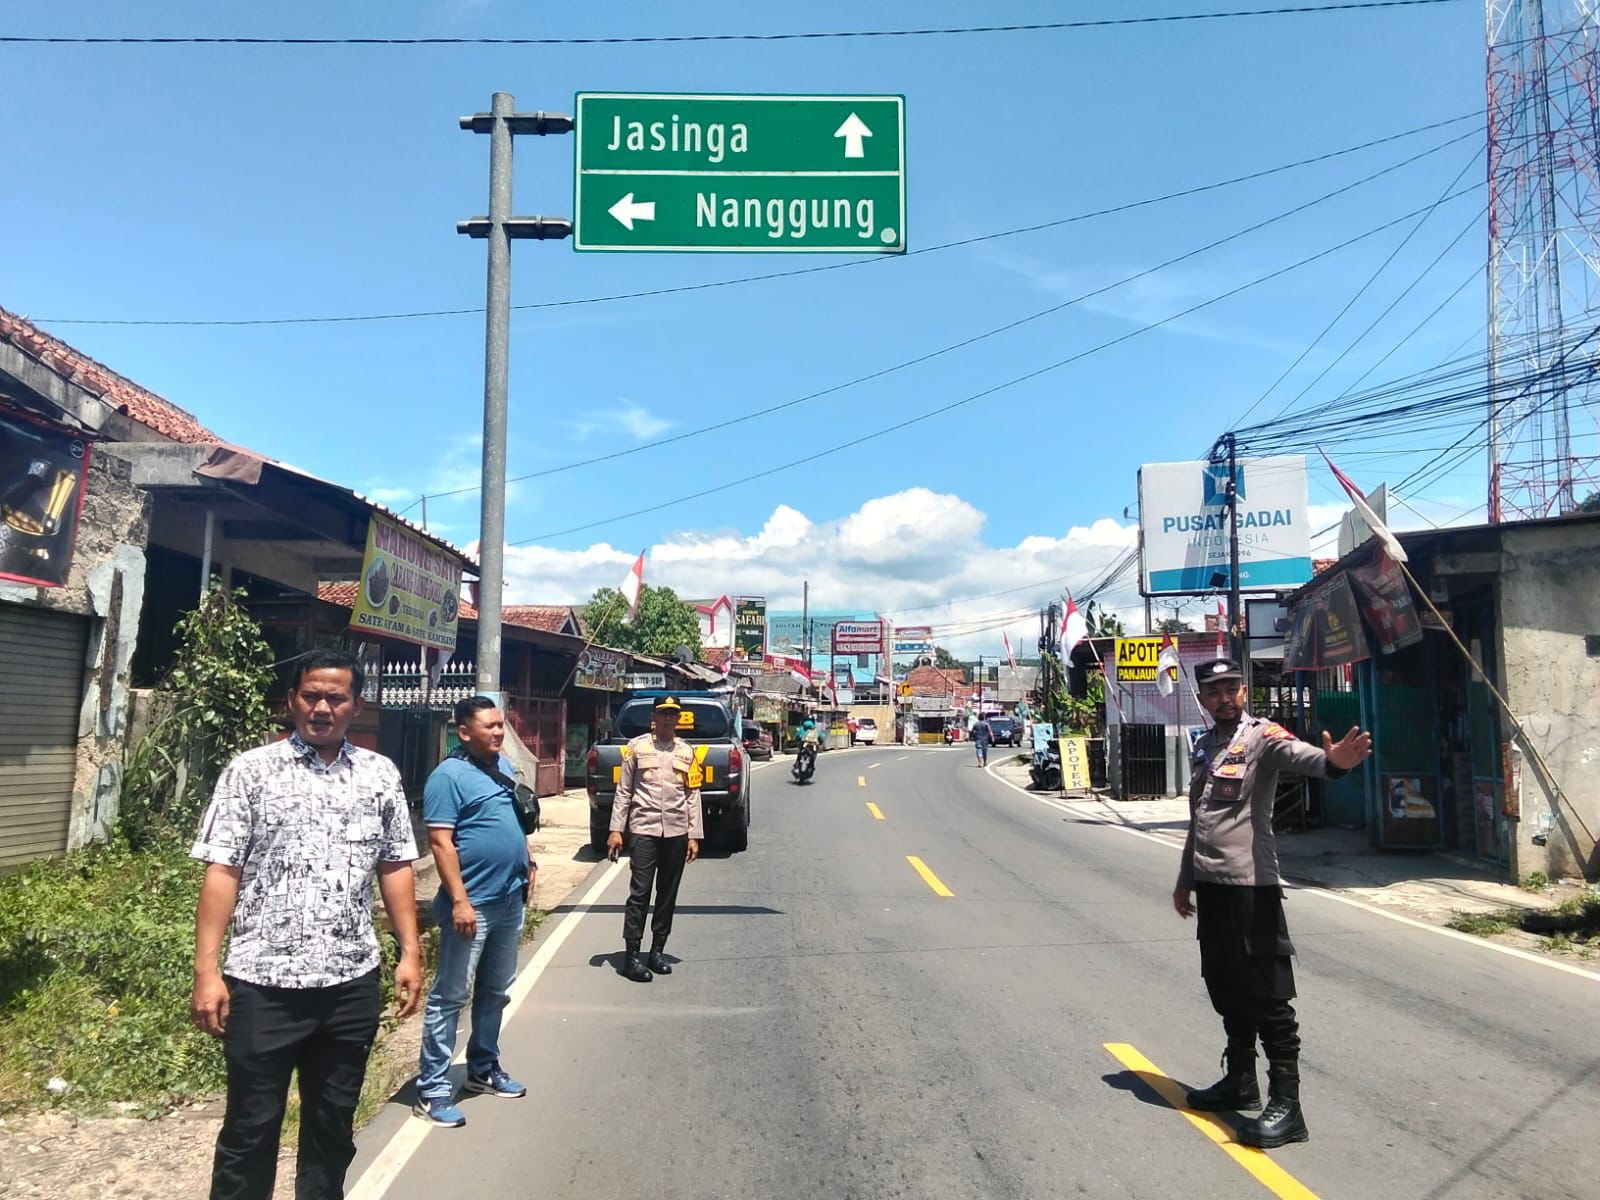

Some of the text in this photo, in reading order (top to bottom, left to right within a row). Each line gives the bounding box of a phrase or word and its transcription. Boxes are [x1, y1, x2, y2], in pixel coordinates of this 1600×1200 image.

[607, 114, 749, 163] Jasinga
[696, 192, 875, 239] Nanggung
[1163, 509, 1292, 533] PUSAT GADAI
[375, 522, 432, 571] WARUNG
[1187, 532, 1269, 548] INDOESIA
[358, 613, 383, 626] SATE
[735, 614, 765, 625] SAFARI
[838, 624, 879, 633] Alfamart
[1118, 641, 1164, 662] APOTE
